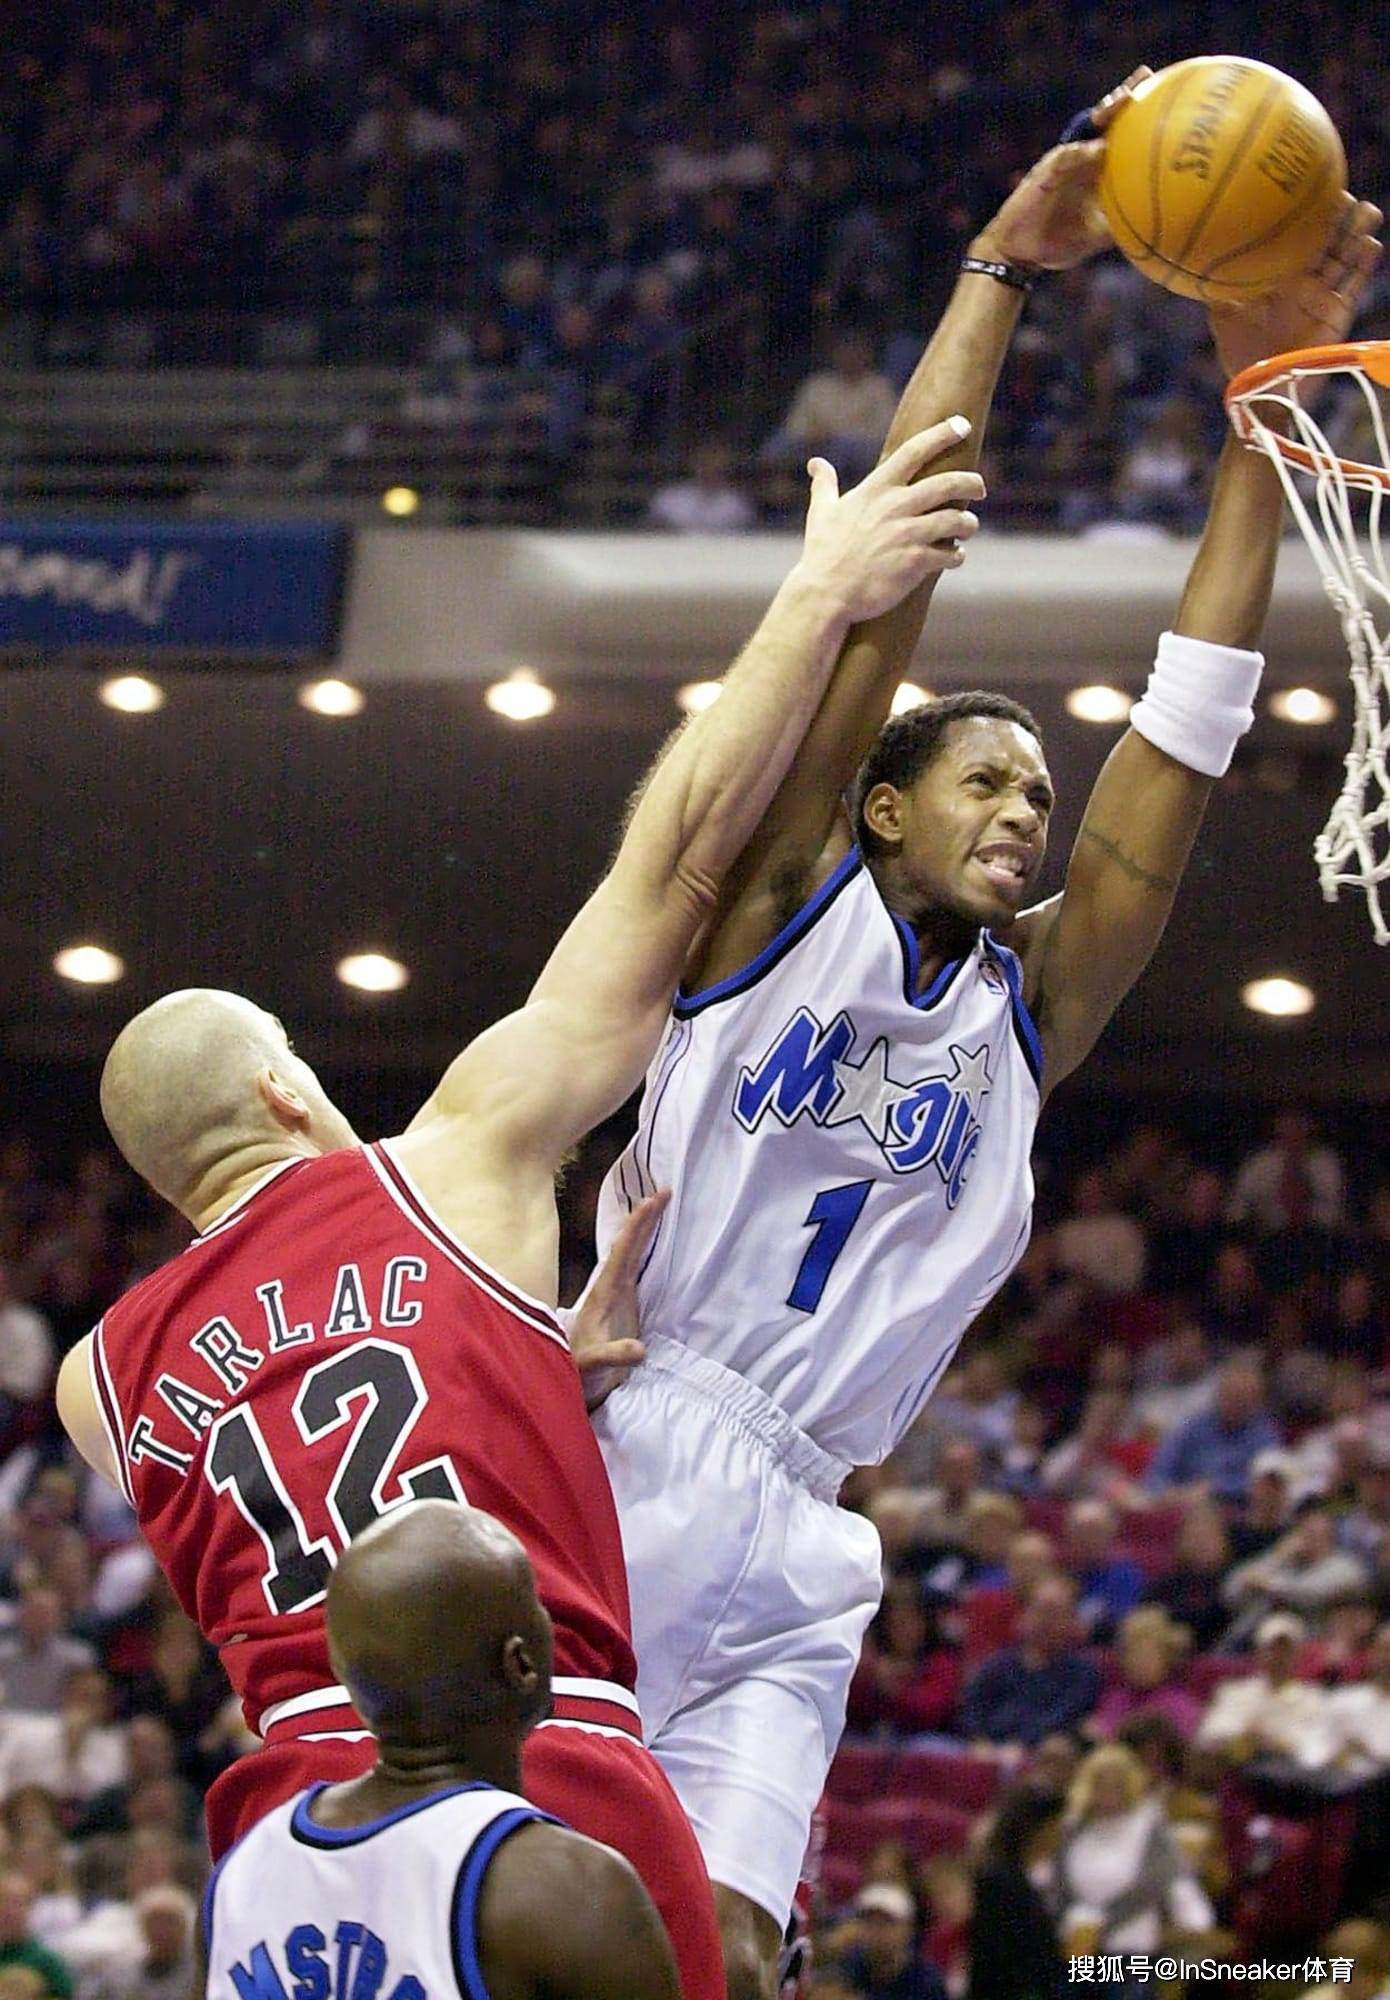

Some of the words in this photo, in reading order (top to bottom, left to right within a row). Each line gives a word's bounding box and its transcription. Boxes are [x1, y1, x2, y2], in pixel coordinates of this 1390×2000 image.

[786, 1178, 877, 1315] 1
[127, 1256, 427, 1476] TARLAC
[204, 1337, 468, 1616] 12
